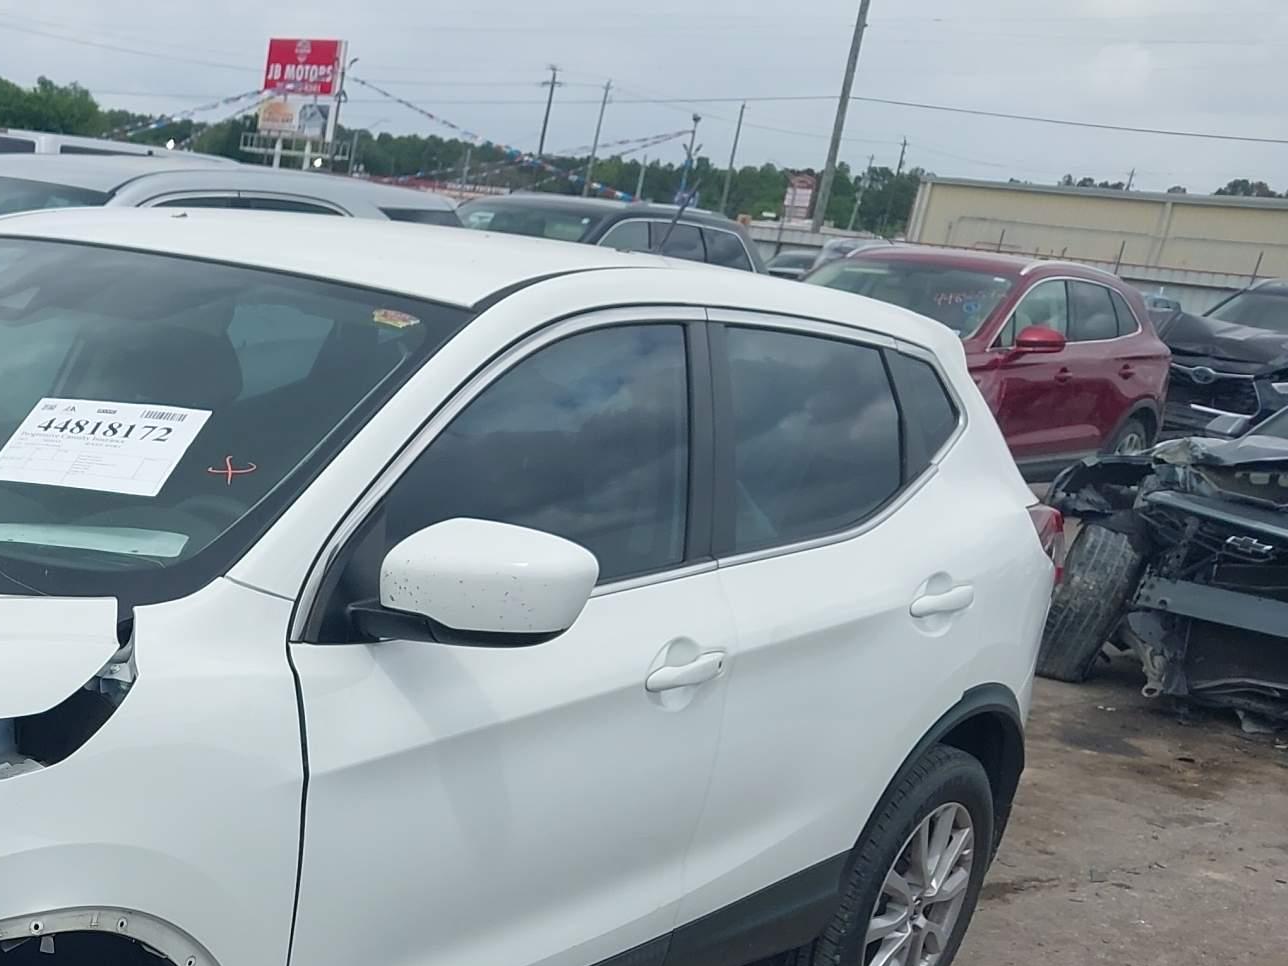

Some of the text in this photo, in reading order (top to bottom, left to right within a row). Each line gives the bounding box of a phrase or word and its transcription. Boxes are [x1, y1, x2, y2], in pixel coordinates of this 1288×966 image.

[267, 63, 333, 83] JB MOTORS
[37, 417, 173, 442] 44818172
